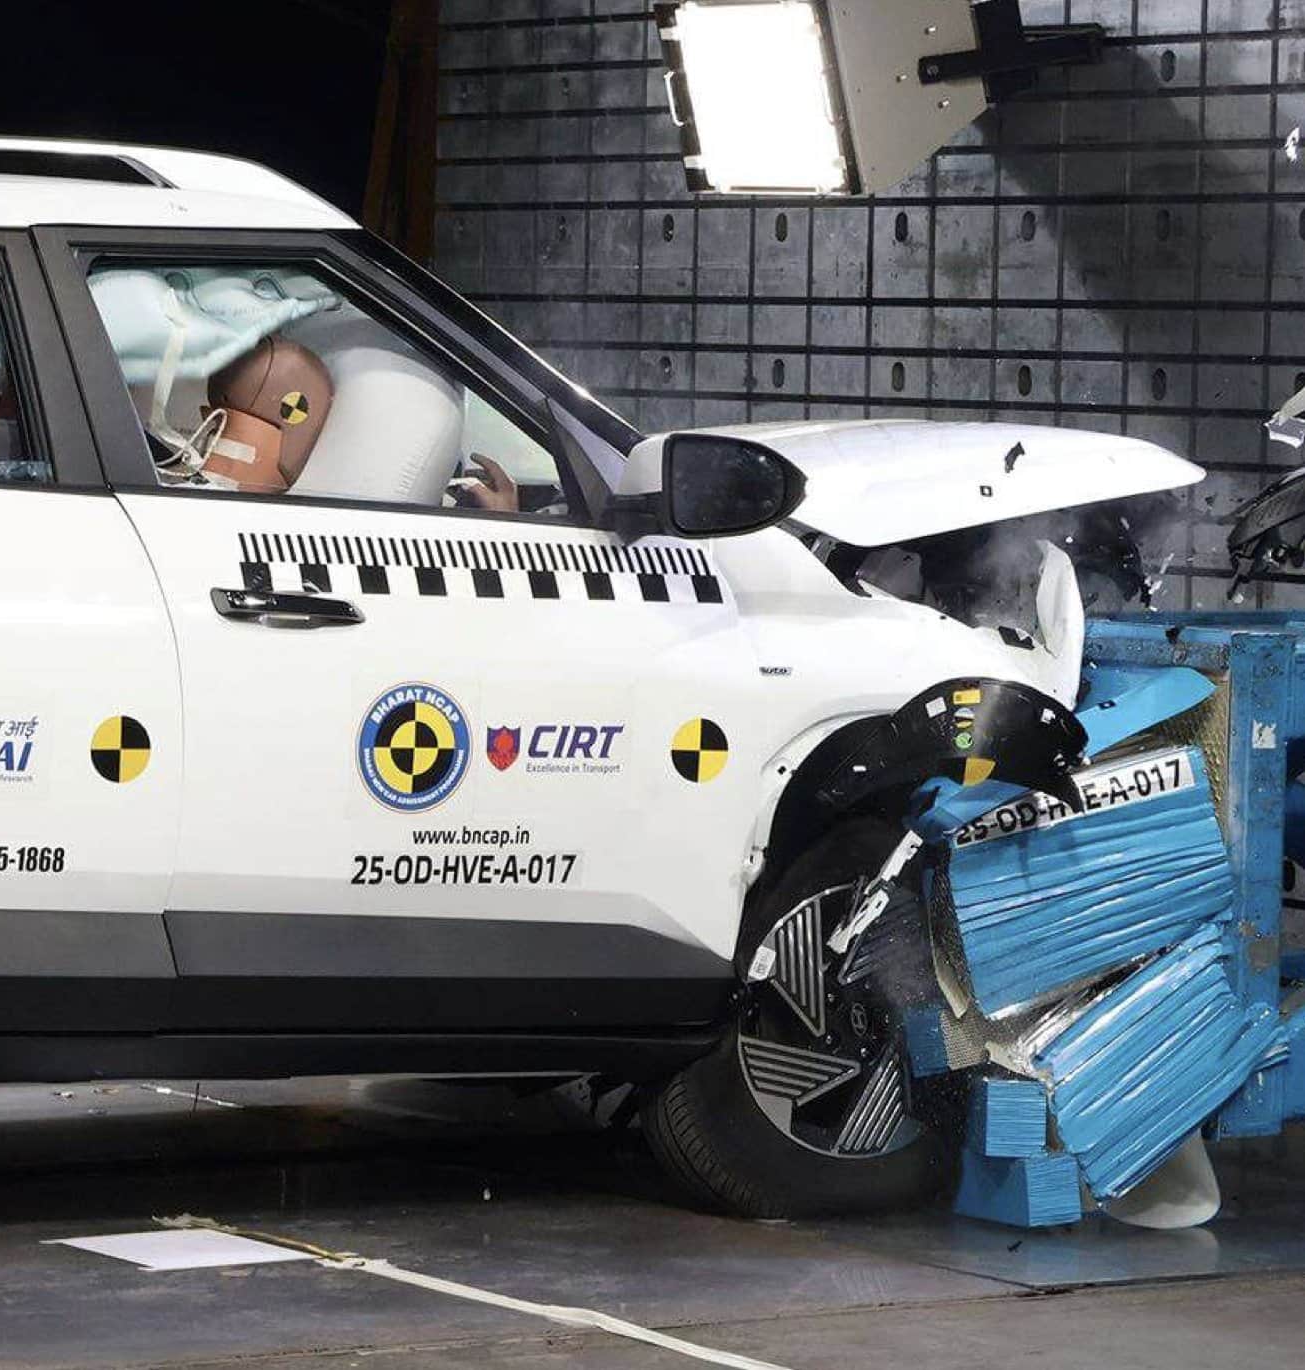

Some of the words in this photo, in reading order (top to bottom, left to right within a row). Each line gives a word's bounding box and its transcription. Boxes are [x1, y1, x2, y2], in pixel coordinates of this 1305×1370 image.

[370, 688, 423, 724] BHARAT
[424, 691, 460, 723] NCAP
[4, 715, 39, 740] आई
[527, 725, 625, 759] CIRT
[526, 763, 570, 773] Excellence
[582, 763, 621, 774] Transport
[956, 757, 1181, 845] 25-OD-HE-A-017
[412, 825, 531, 848] www.bncap.in
[350, 854, 577, 885] 25-OD-HVE-A-017
